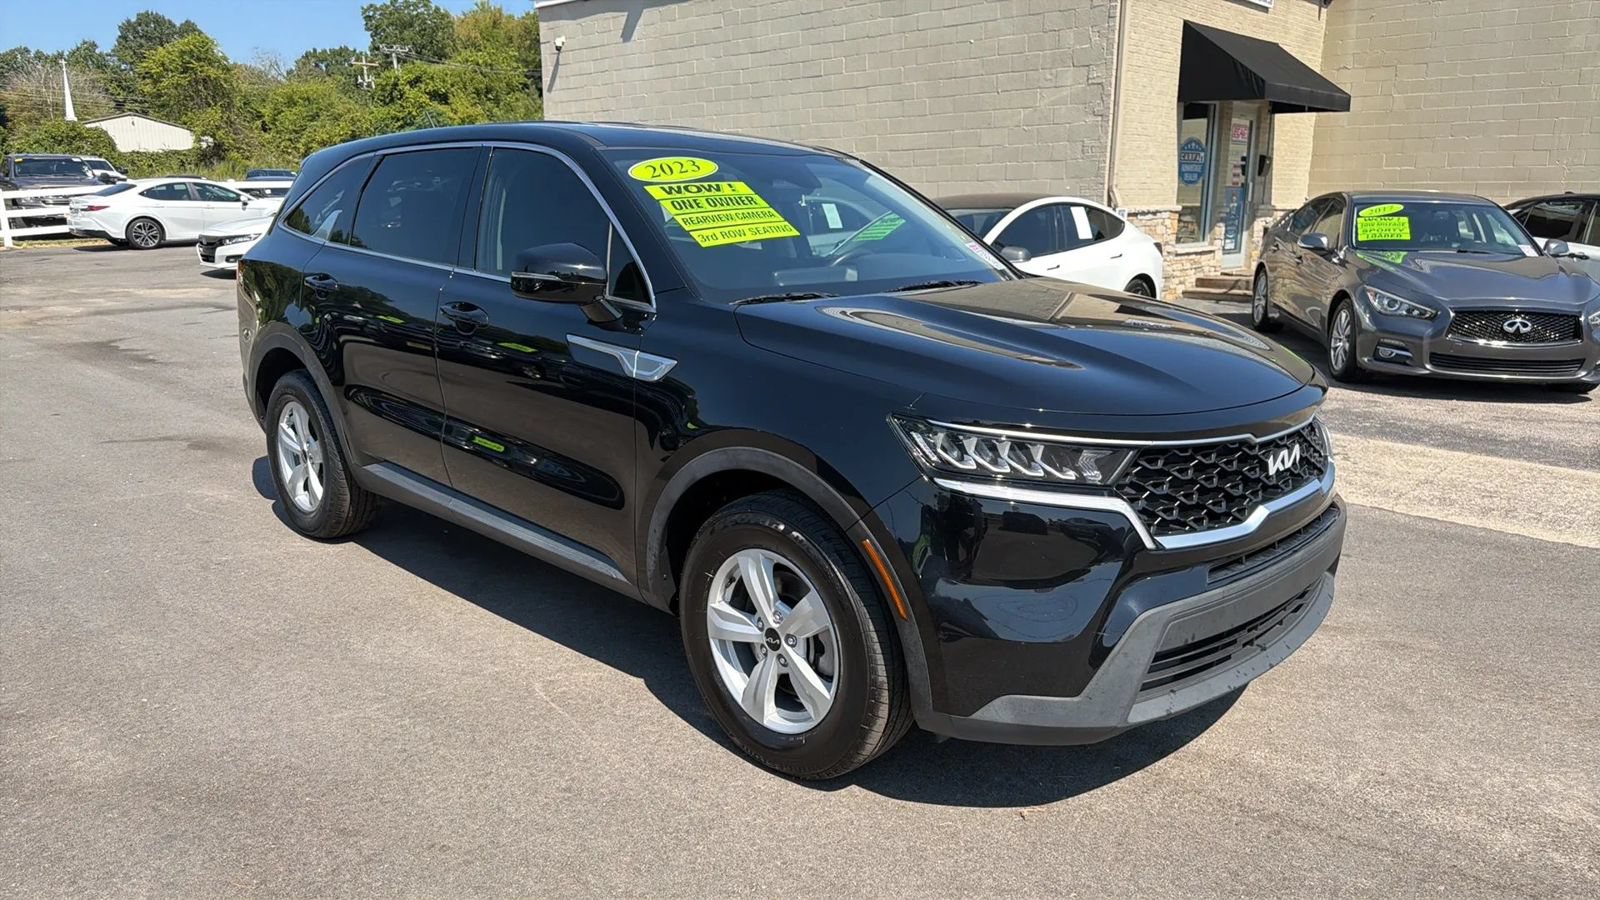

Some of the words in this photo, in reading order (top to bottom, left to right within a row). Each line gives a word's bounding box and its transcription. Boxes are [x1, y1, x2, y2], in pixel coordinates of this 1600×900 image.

[645, 160, 701, 178] 2023
[660, 183, 721, 195] WOW
[671, 198, 703, 210] ONE
[705, 196, 758, 208] OWNER
[1370, 205, 1394, 213] 2017
[682, 213, 734, 226] REARVIEW
[734, 210, 775, 220] CAMERA
[698, 232, 718, 243] 3rd
[720, 230, 746, 240] ROW
[748, 224, 793, 236] SEATING
[1268, 443, 1300, 476] KIA
